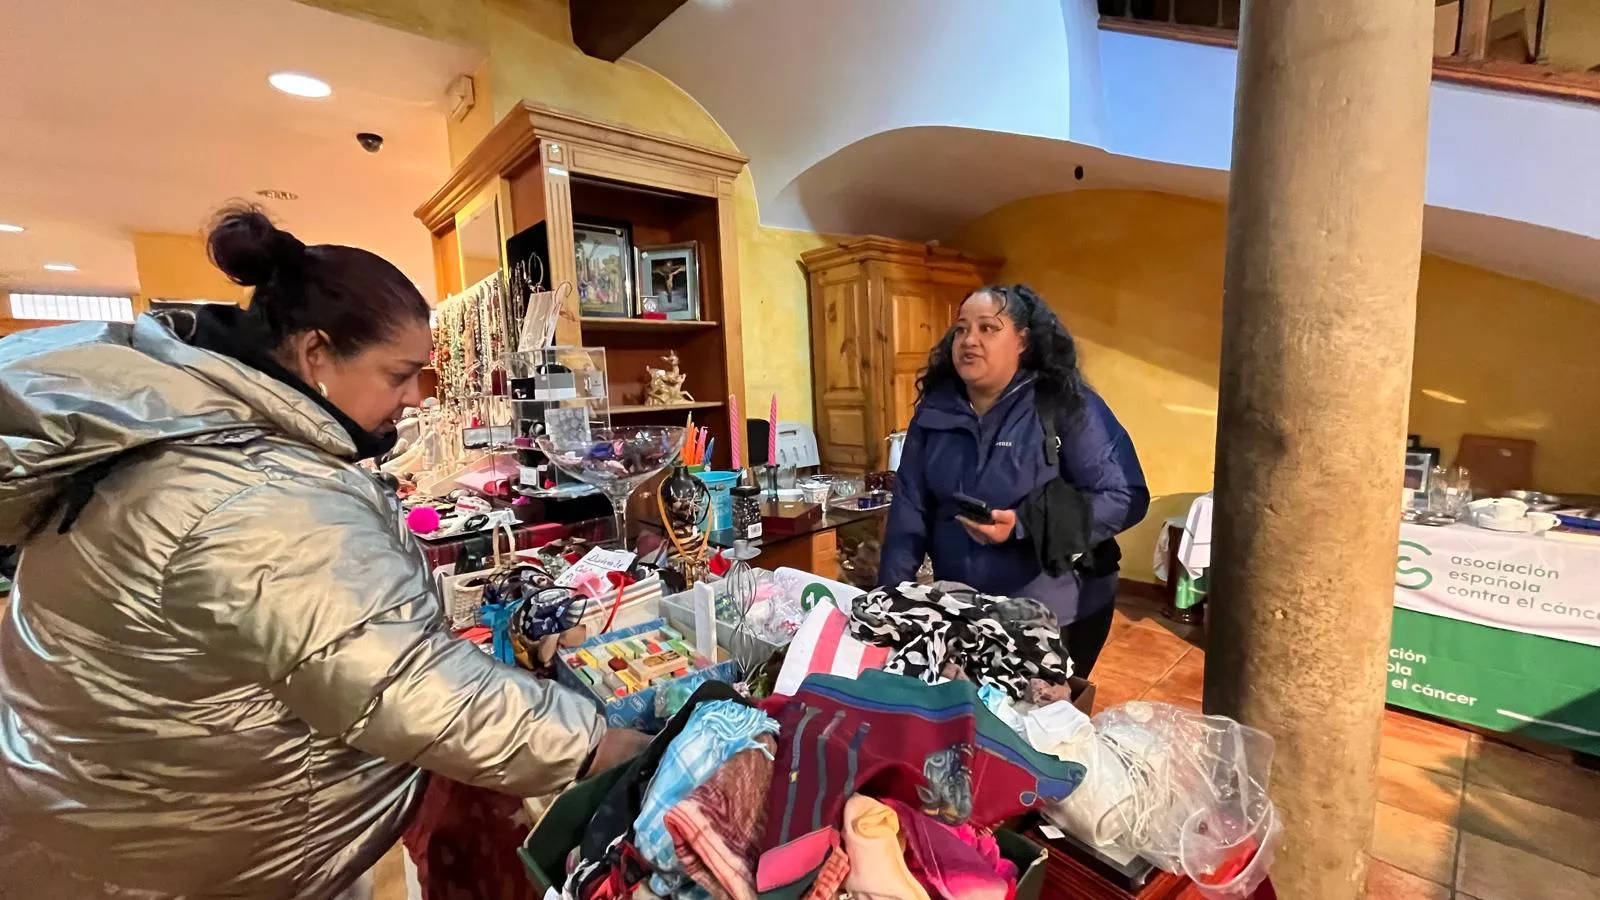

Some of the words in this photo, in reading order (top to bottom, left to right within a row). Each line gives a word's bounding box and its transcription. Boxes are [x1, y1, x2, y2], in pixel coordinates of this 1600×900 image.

[1451, 554, 1560, 580] asociación
[1448, 570, 1541, 593] española
[1447, 584, 1510, 606] contra
[1516, 597, 1535, 609] el
[1391, 678, 1408, 690] el
[1411, 684, 1478, 707] cáncer
